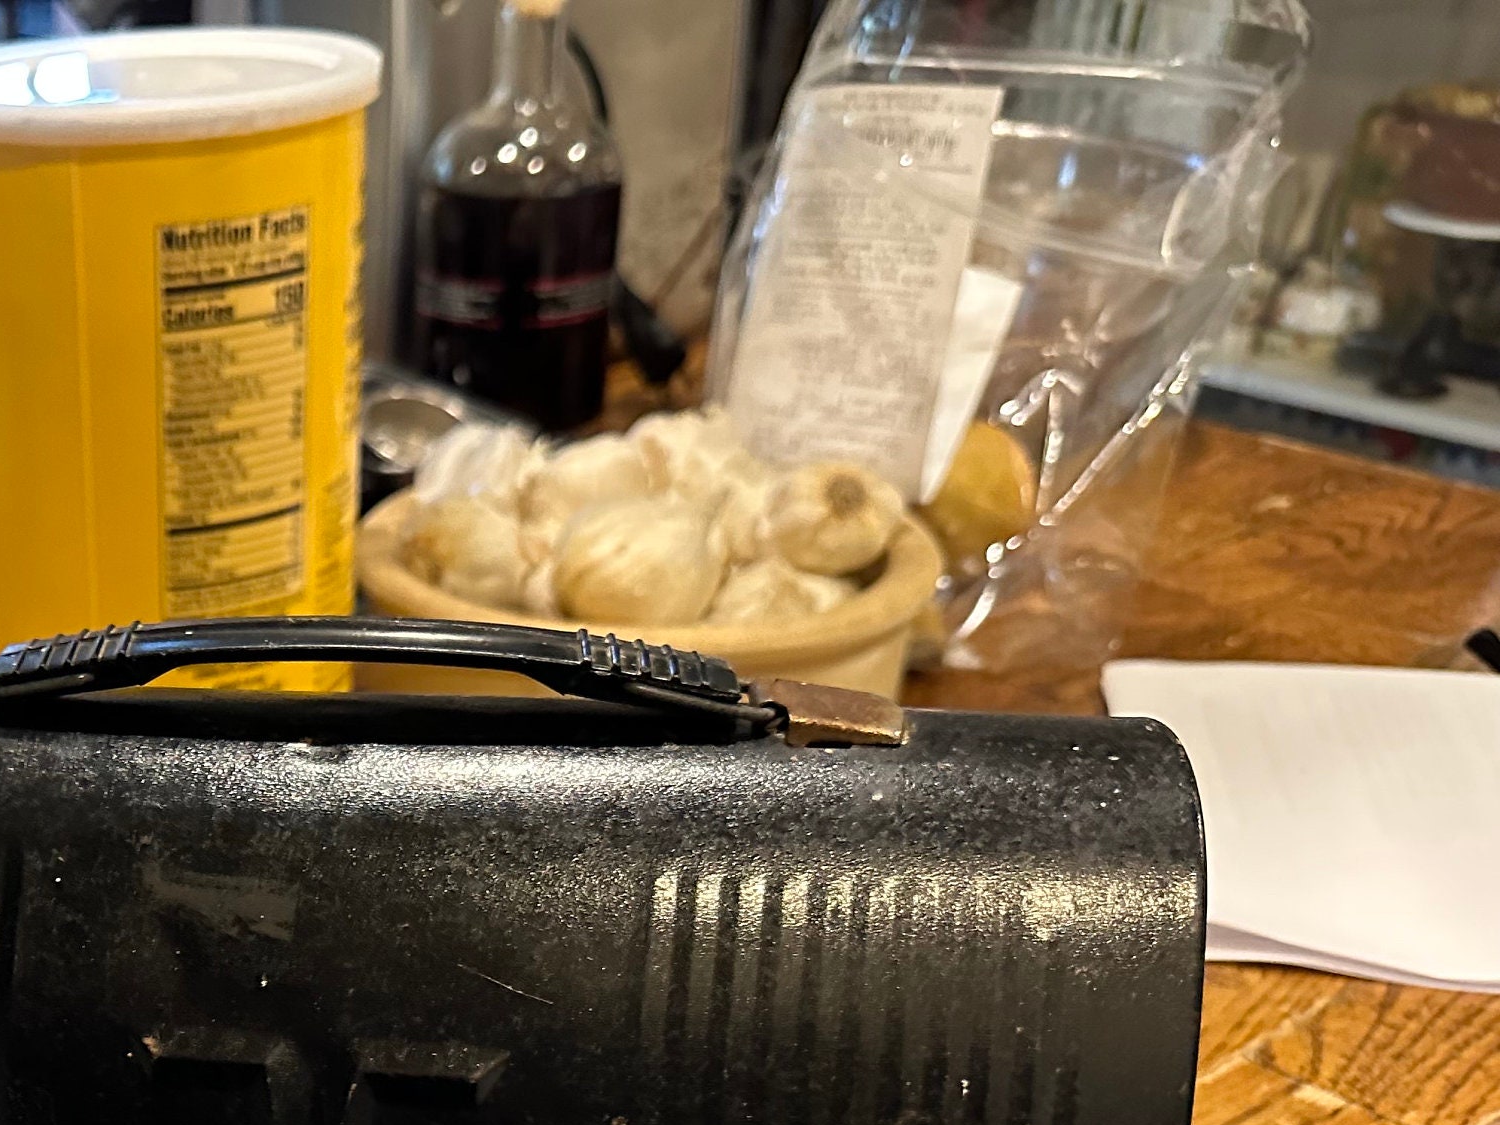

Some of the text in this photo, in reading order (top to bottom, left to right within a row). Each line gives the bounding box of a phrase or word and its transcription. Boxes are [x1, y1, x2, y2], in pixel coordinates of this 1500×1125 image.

[163, 212, 305, 252] Nutrition Facts
[164, 305, 234, 333] Calories
